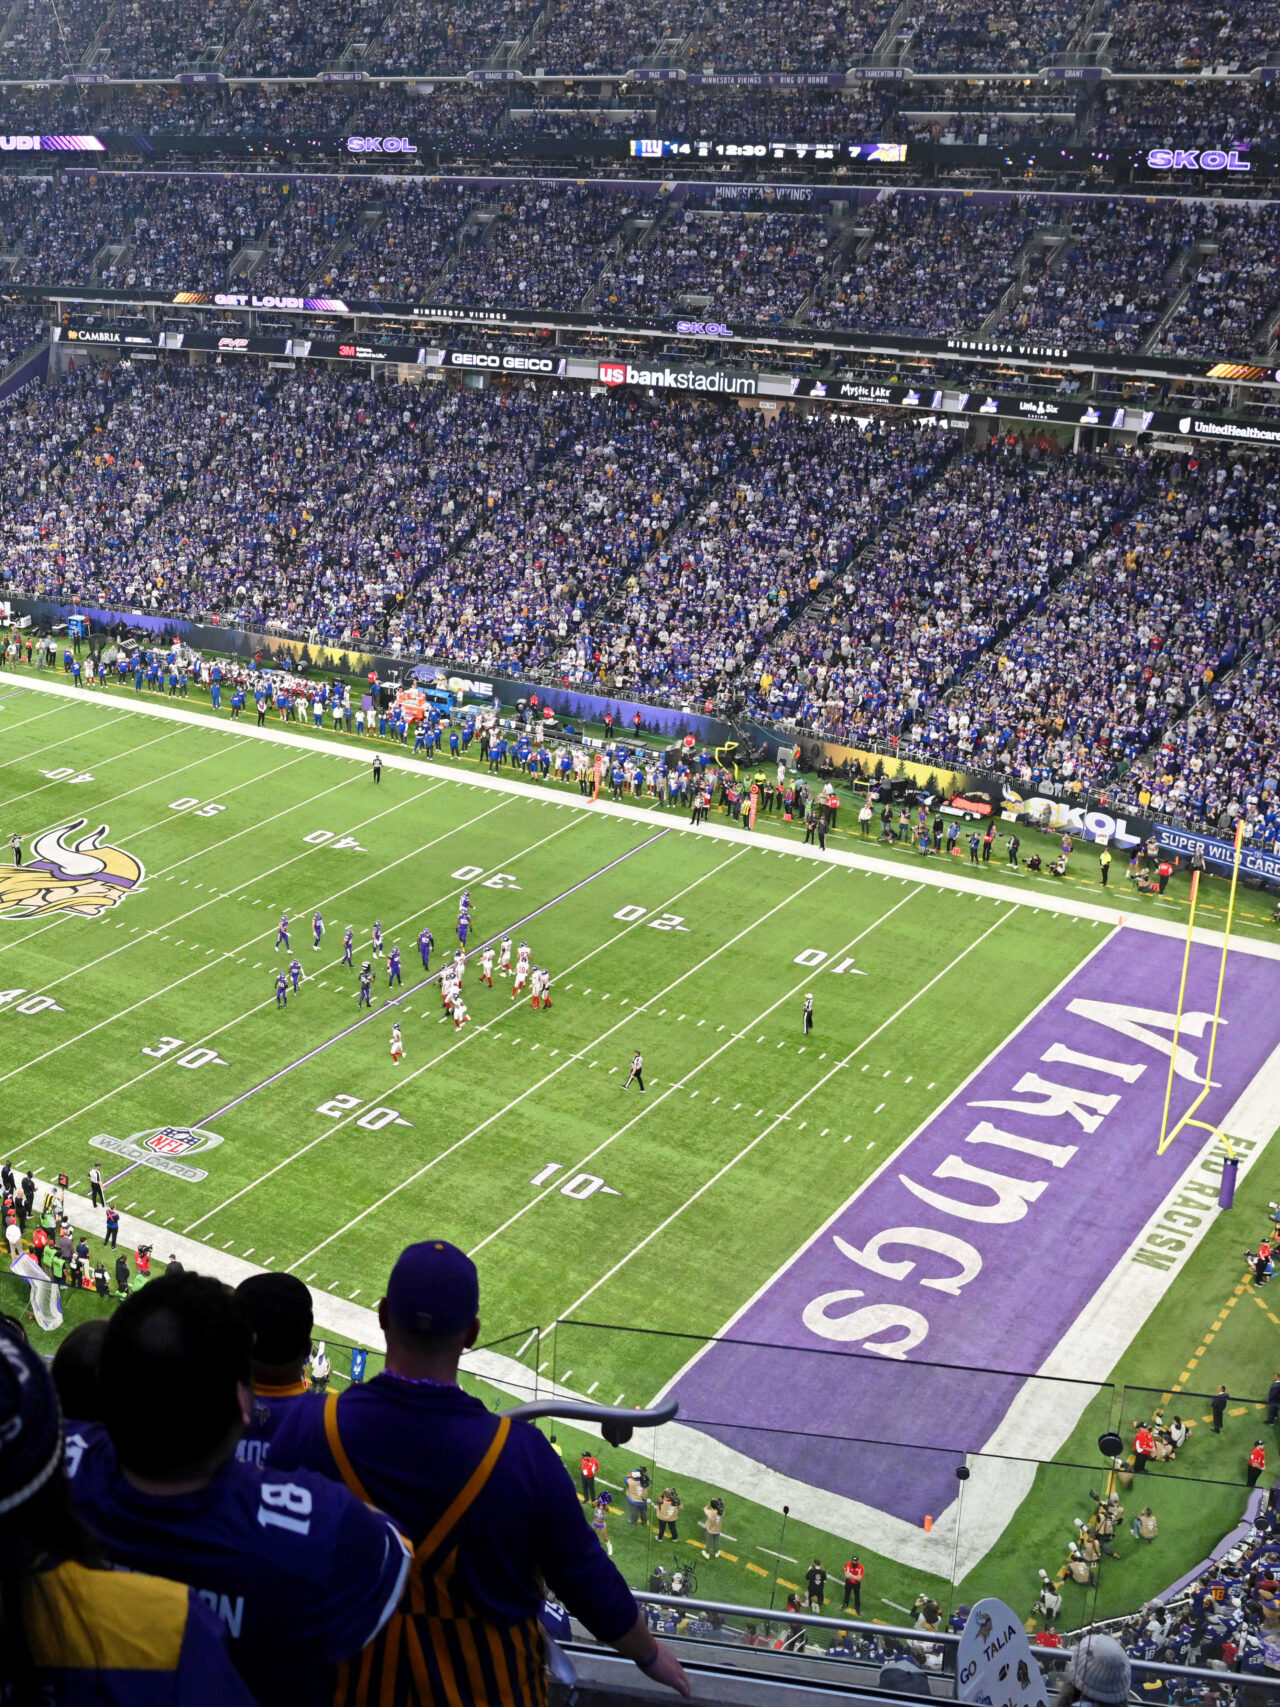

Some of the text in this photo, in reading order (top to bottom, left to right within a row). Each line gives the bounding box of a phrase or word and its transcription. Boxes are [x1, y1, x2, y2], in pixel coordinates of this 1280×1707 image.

[701, 76, 735, 84] MINNESOTA
[737, 76, 762, 84] VIKINGS
[797, 76, 805, 84] OF
[1064, 70, 1084, 78] GRANT
[347, 137, 417, 152] SKOL
[670, 143, 690, 155] 14
[716, 145, 767, 156] 12:30
[1148, 149, 1251, 170] SKOL
[214, 294, 304, 308] GET LOUD!
[413, 308, 508, 321] MINNESOTA VIKINGS
[78, 330, 120, 342] CAMBRIA
[676, 321, 733, 336] SKOL
[218, 338, 248, 347] FVP
[339, 345, 356, 356] 3M
[947, 340, 1068, 358] MINNESOTA VIKINGS
[451, 352, 552, 371] GEICO GEICO
[0, 376, 41, 408] PENTAIR
[449, 677, 493, 696] ONE
[1024, 796, 1141, 845] SKOL
[1161, 831, 1280, 877] SUPER WILD CARD
[141, 1036, 219, 1069] 30
[315, 1093, 401, 1131] 20
[149, 1135, 184, 1154] NFL
[99, 1138, 198, 1179] WILD CARD
[529, 1162, 607, 1200] 10
[1131, 1180, 1221, 1273] RACISM
[257, 1482, 313, 1536] 18
[960, 1624, 1017, 1685] GO TALIA
